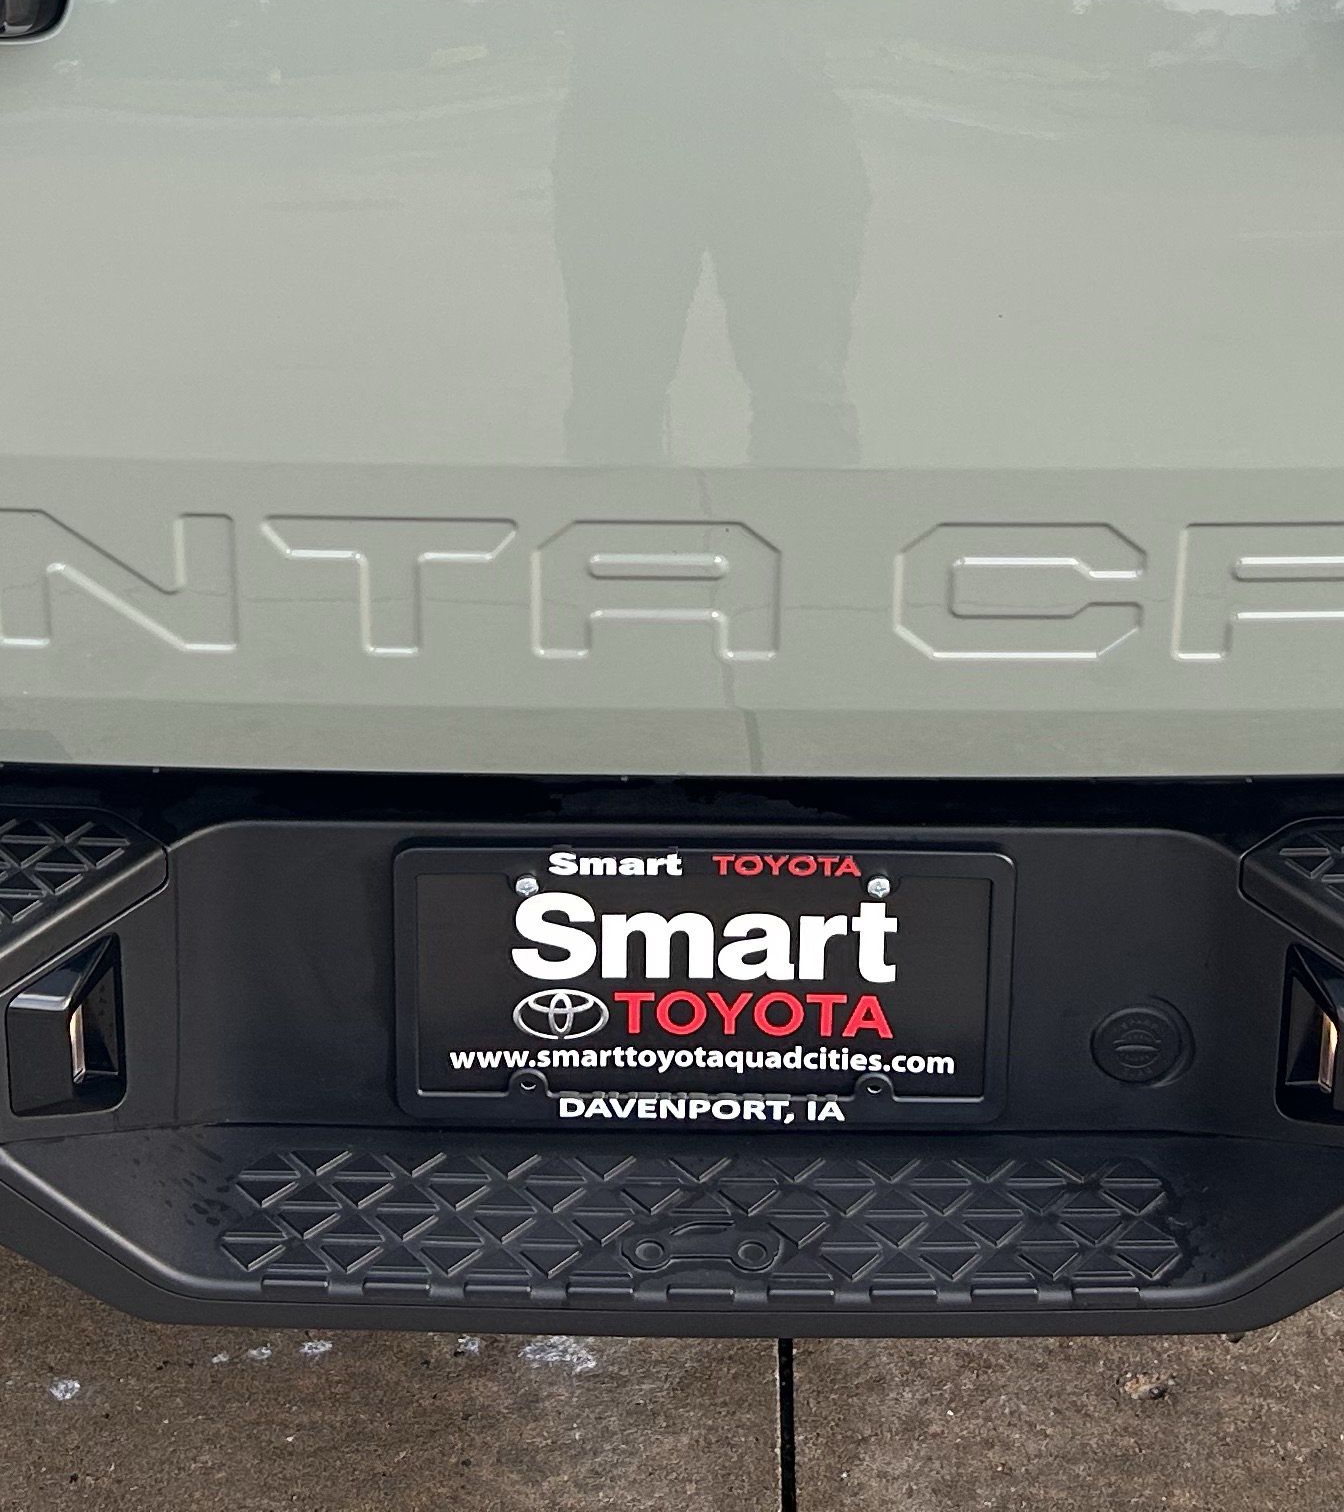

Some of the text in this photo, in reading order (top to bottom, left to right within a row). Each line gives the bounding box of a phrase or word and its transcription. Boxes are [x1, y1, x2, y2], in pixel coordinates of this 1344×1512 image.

[548, 851, 862, 878] Smart TOYOTA
[511, 891, 898, 984] Smart
[614, 990, 894, 1040] TOYOTA
[449, 1044, 955, 1076] www.smarttoyotaquadcities.com
[559, 1096, 846, 1125] DAVENPORT, IA
